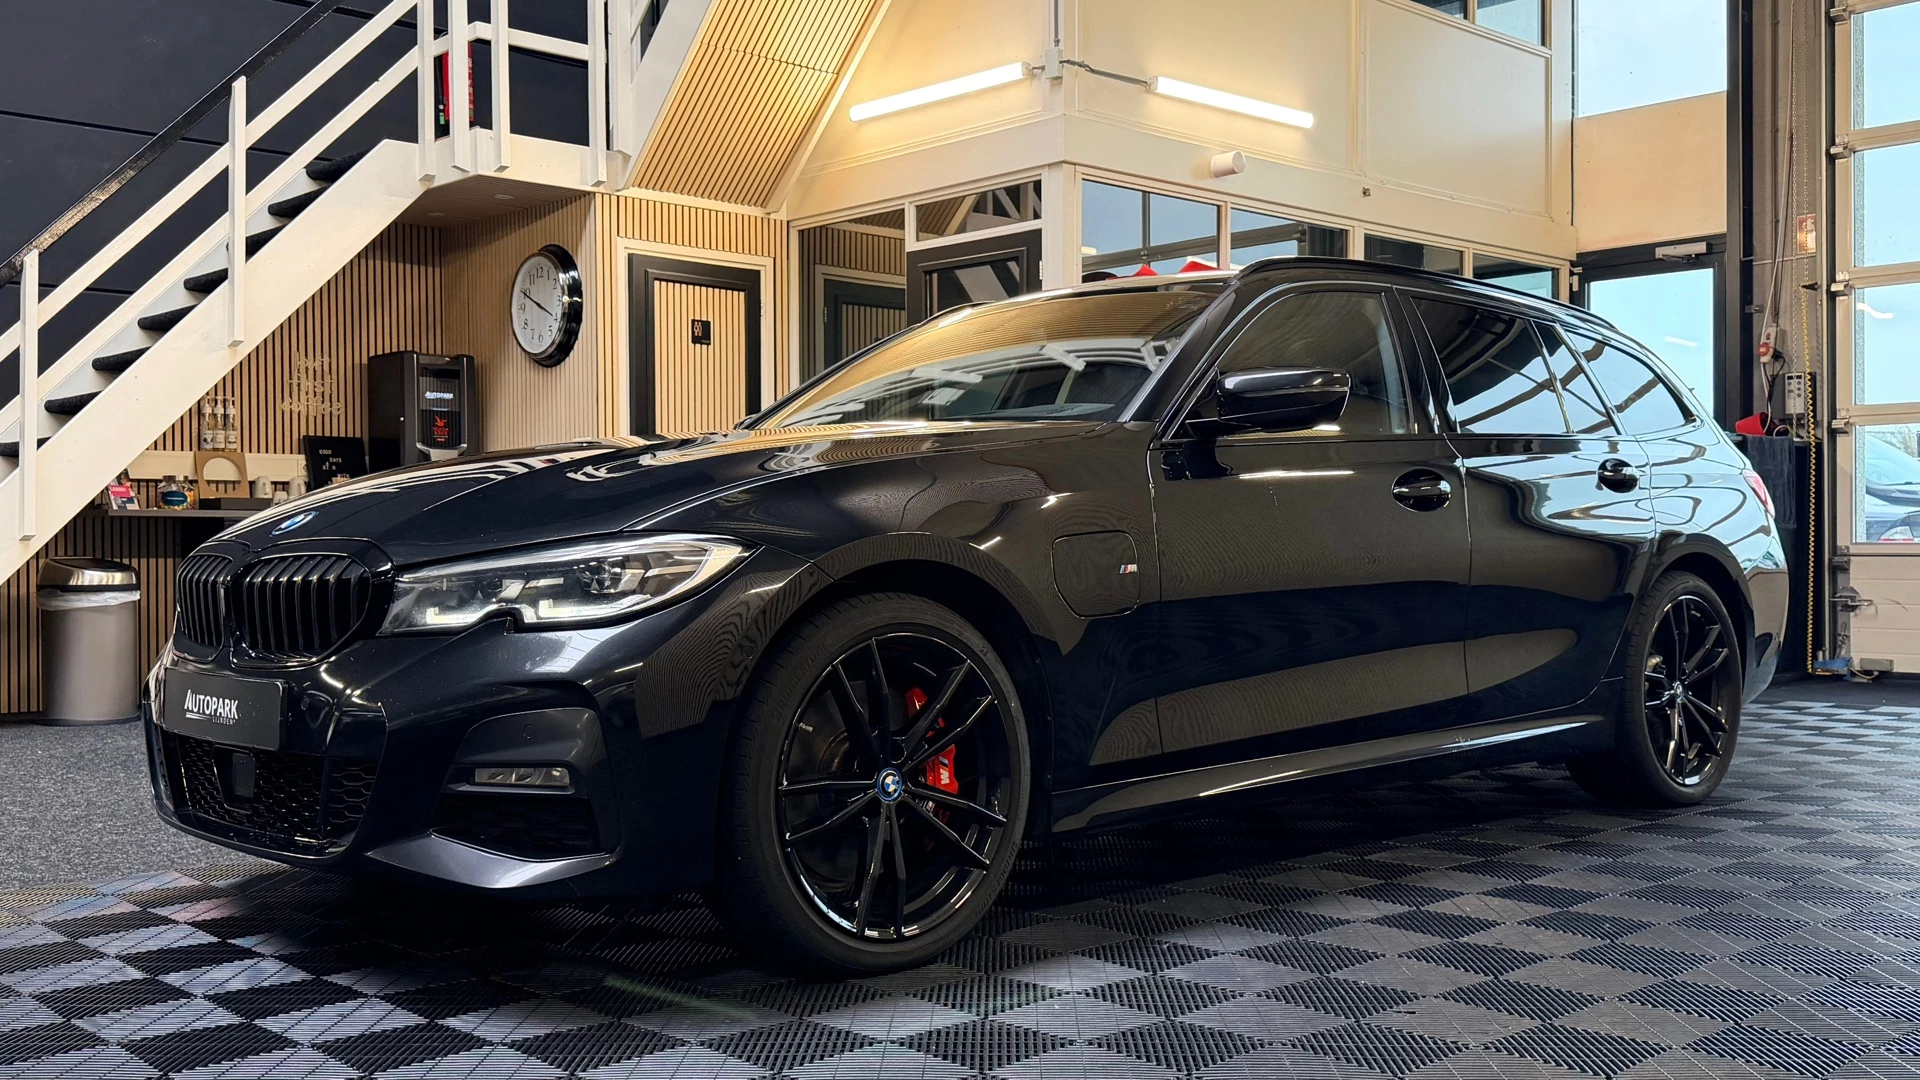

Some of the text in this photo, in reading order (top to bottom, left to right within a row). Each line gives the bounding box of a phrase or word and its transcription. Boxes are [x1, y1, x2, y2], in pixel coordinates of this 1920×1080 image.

[536, 266, 544, 278] 12
[529, 274, 535, 285] 11
[522, 287, 531, 299] 10
[282, 395, 342, 417] coffee
[184, 689, 238, 719] AUTOPARK
